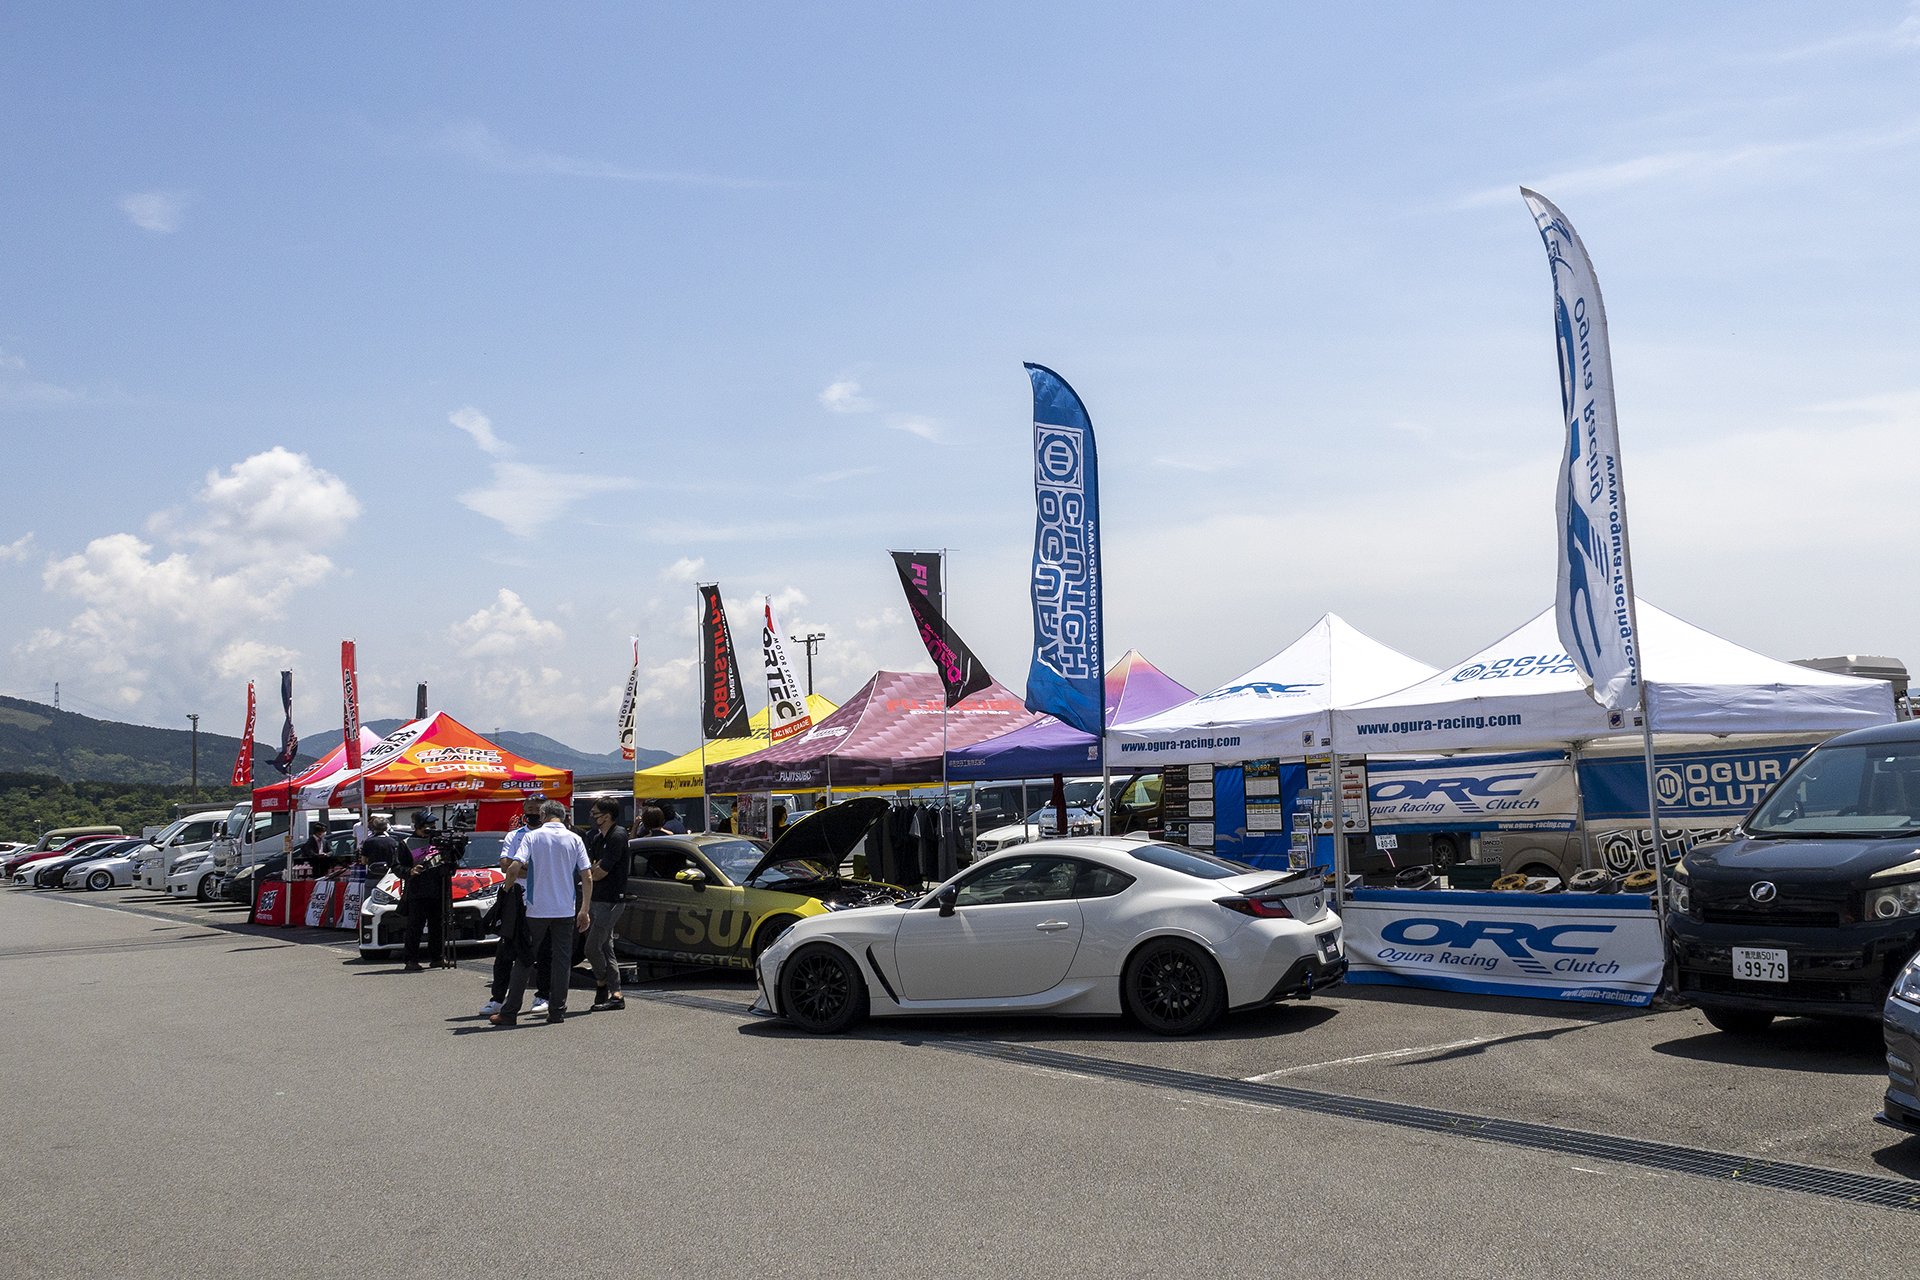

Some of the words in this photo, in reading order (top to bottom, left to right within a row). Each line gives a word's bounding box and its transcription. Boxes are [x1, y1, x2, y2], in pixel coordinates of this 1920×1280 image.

[773, 637, 788, 666] MOTOR
[783, 668, 799, 699] SPORTS
[795, 701, 804, 716] OIL
[1479, 664, 1576, 681] CLUTC
[1199, 681, 1325, 701] ORC
[886, 699, 1021, 713] FUJISUBO
[1357, 712, 1522, 736] www.ogura-racing.com
[442, 746, 499, 758] ACRE
[1121, 735, 1241, 753] www.ogura-racing.com
[419, 754, 503, 765] BRAKES
[374, 778, 486, 793] www.acre.co.jp
[501, 779, 545, 790] SPIRIT
[1367, 772, 1539, 804] ORC
[1688, 781, 1777, 808] CLUT
[1369, 803, 1397, 817] gura
[1399, 801, 1446, 815] Racing
[1486, 797, 1540, 811] Clutch
[1498, 821, 1572, 831] www.ogura-racing.com
[1380, 917, 1618, 958] ORC
[1377, 947, 1435, 964] Ogura
[1439, 951, 1500, 971] Racing
[1553, 957, 1621, 975] Clutch
[1744, 960, 1786, 980] 99-79
